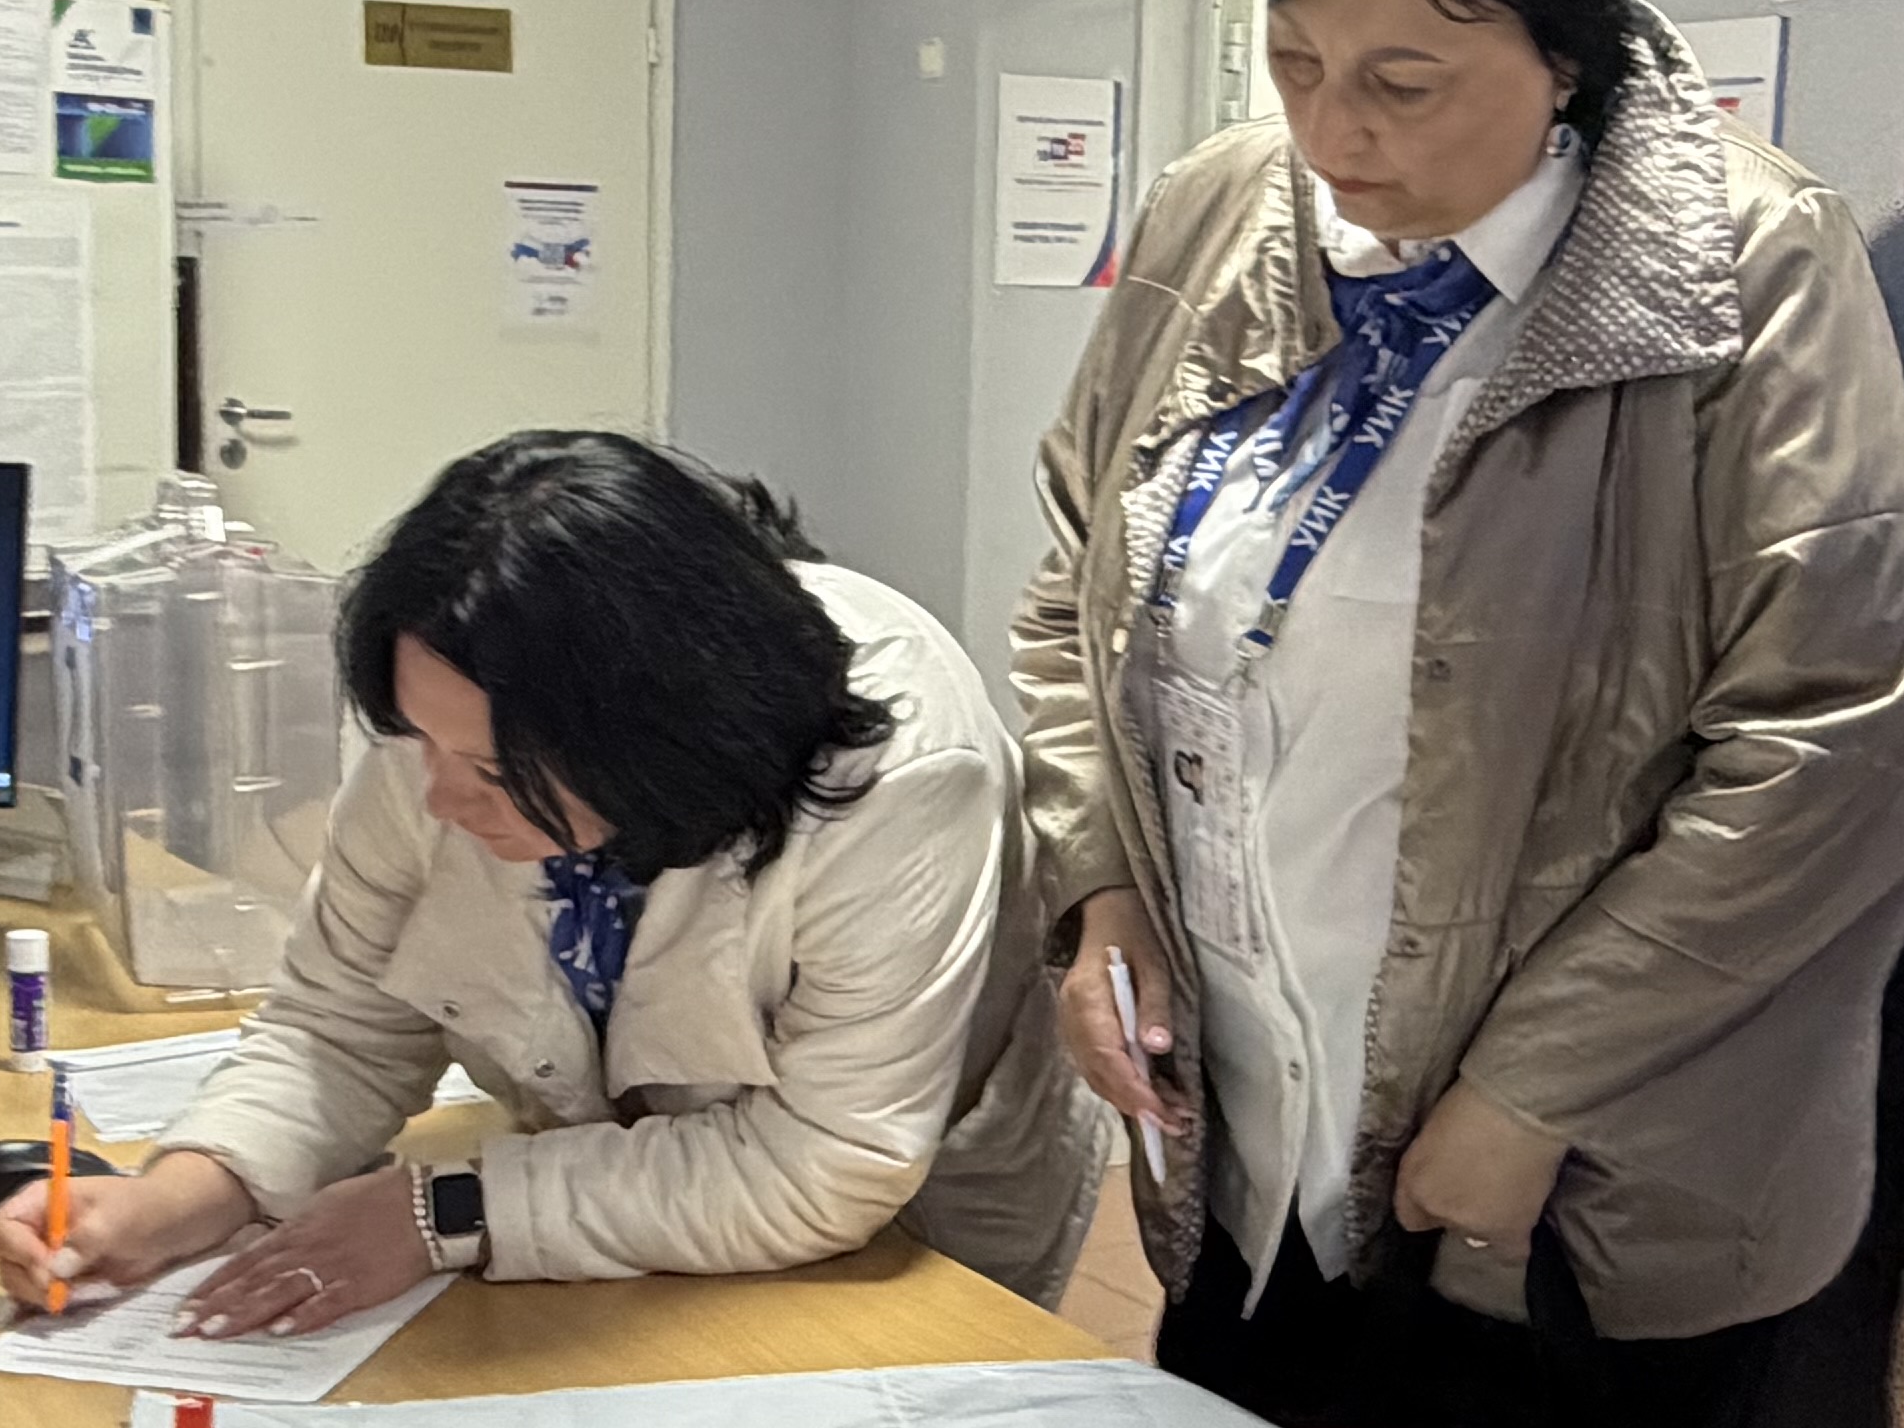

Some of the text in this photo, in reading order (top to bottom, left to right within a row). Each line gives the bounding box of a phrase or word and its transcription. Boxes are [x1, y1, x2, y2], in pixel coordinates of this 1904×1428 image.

[1353, 384, 1415, 448] УИК
[1187, 430, 1238, 492] УИК
[1291, 485, 1351, 551] УИК
